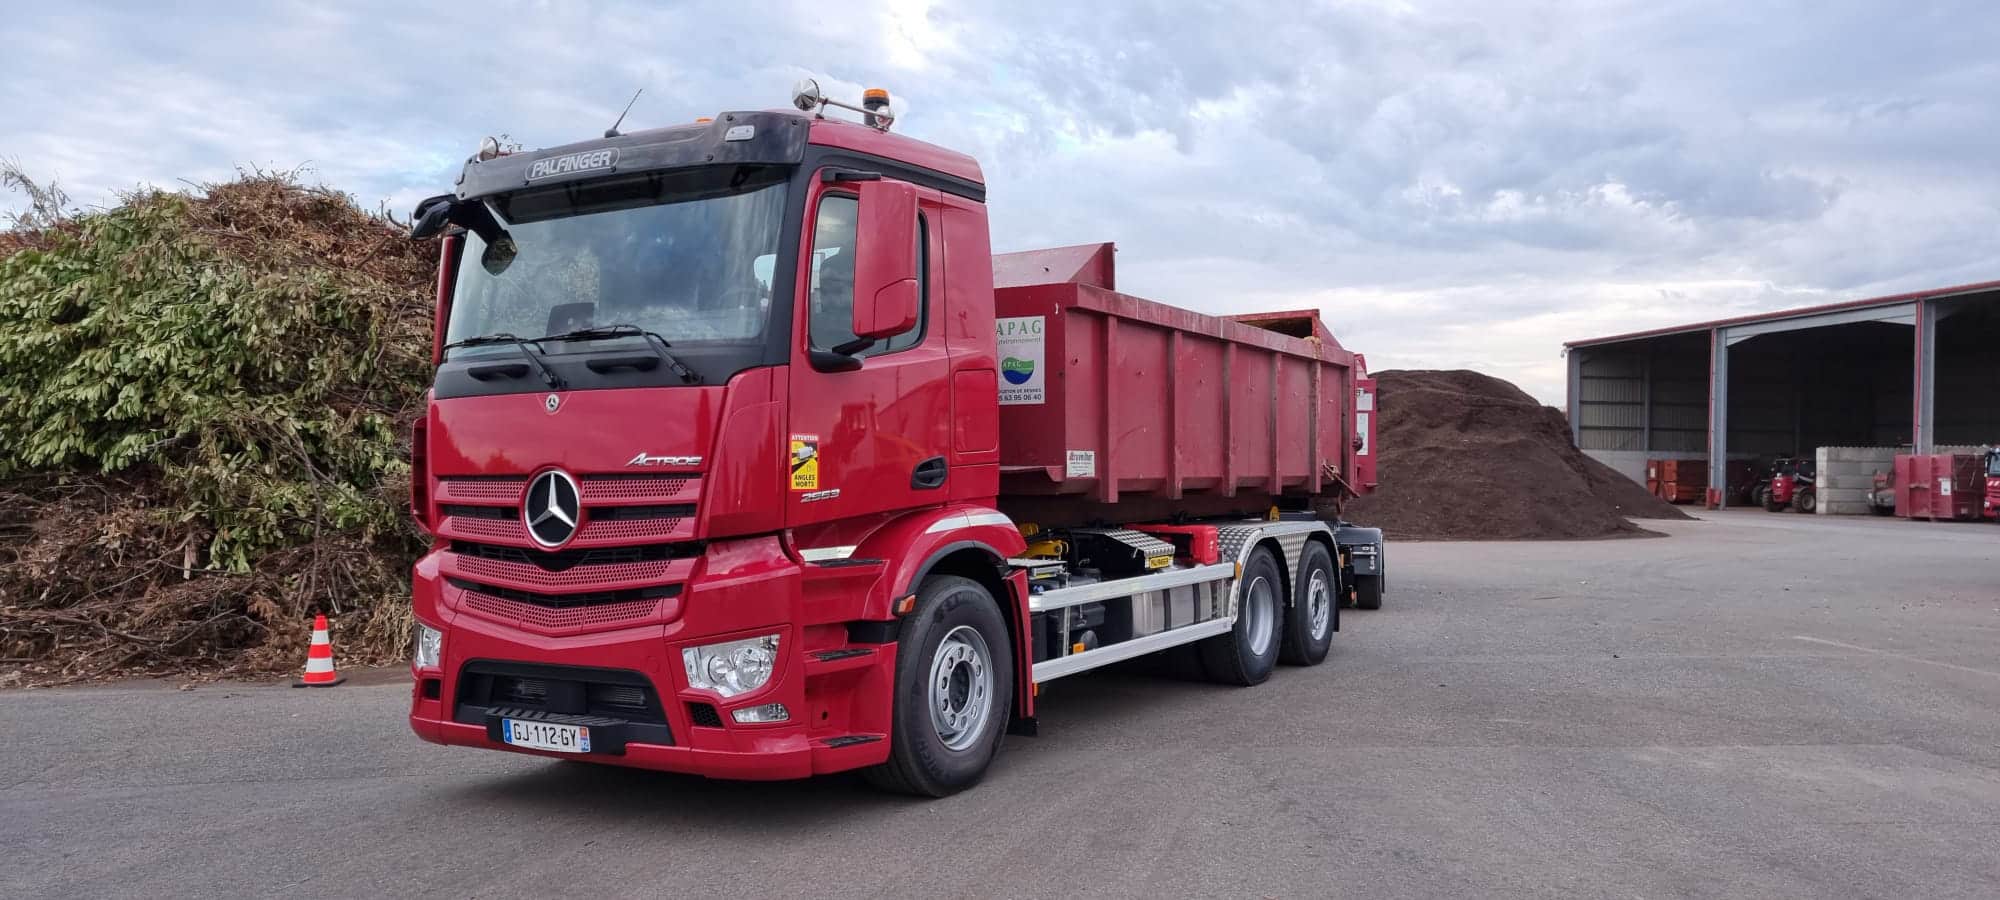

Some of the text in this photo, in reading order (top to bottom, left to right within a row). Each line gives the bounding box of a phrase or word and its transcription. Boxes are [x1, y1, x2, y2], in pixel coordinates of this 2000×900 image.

[530, 150, 612, 178] PALFINGER
[996, 320, 1042, 336] APAG
[513, 722, 576, 747] GJ-112-GY
